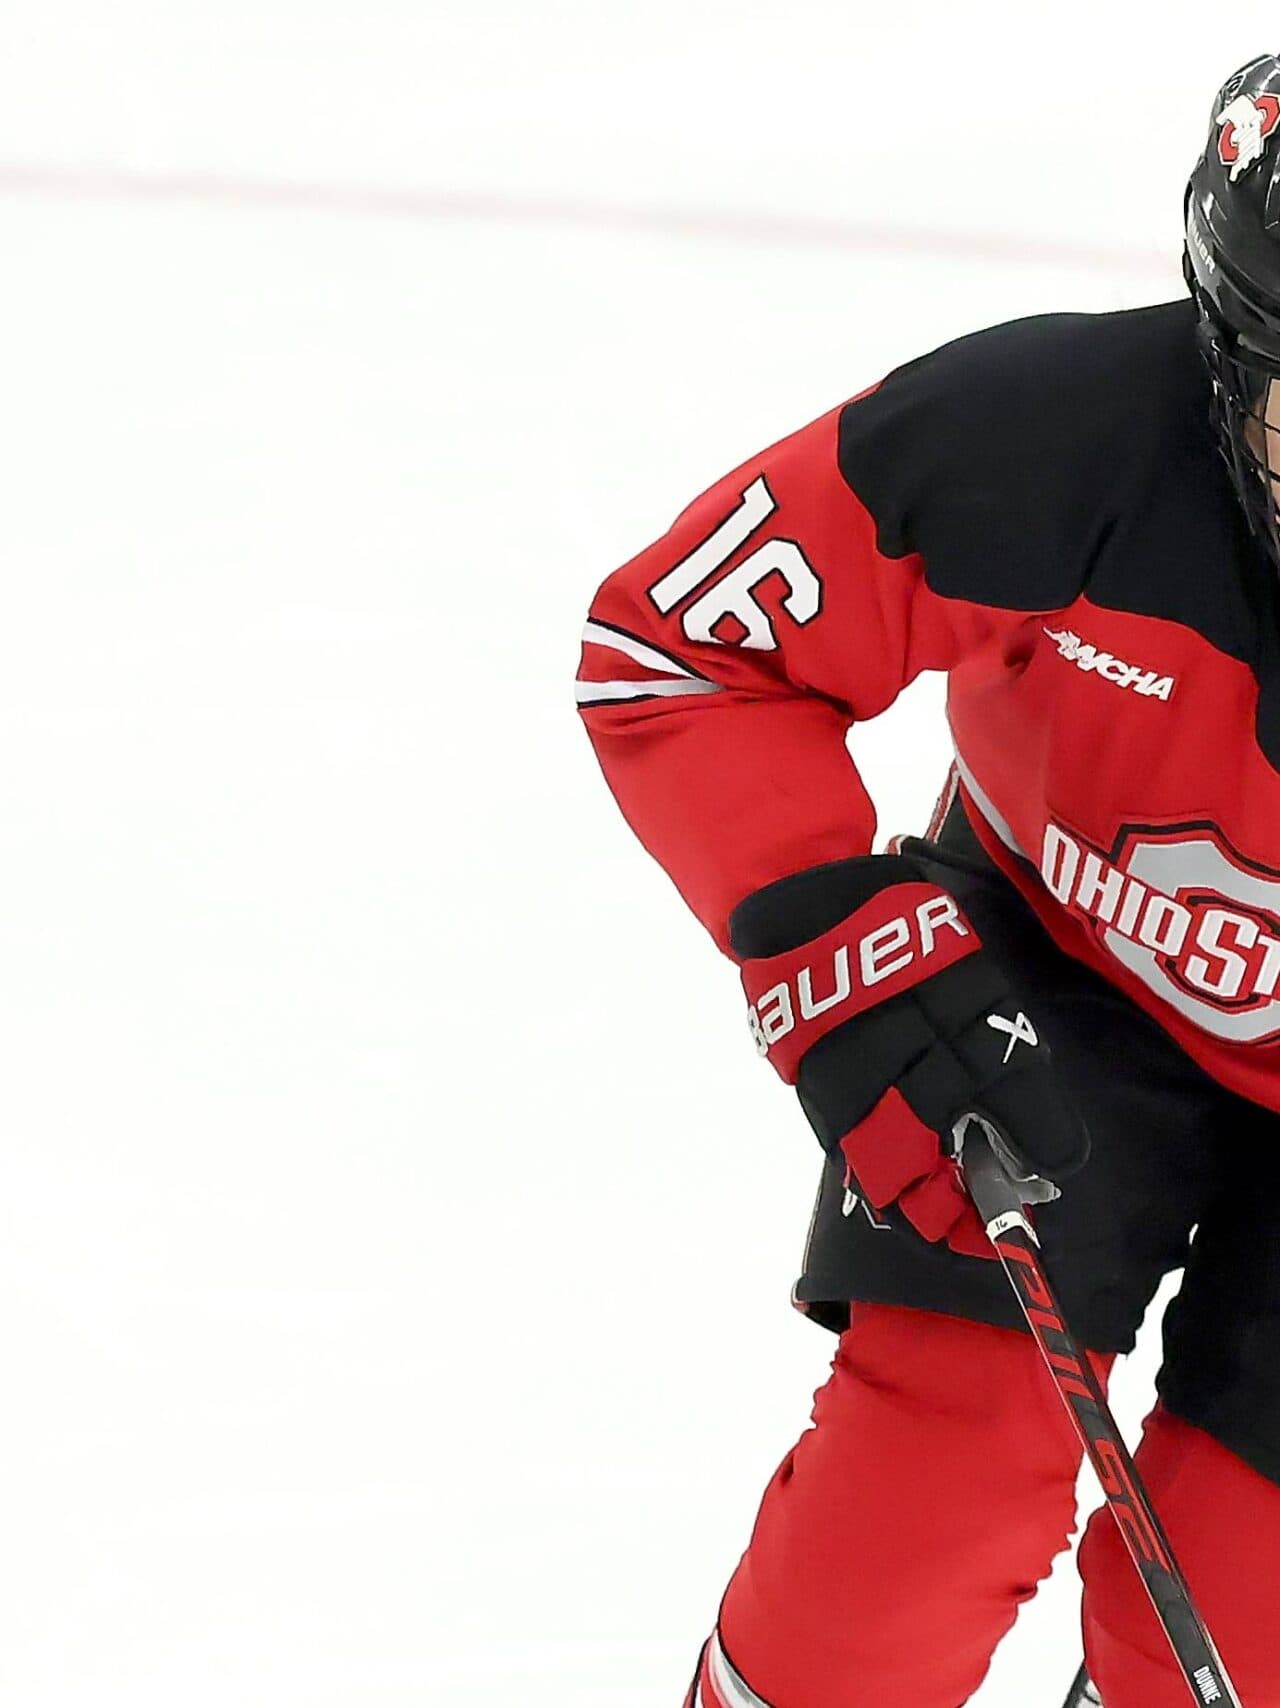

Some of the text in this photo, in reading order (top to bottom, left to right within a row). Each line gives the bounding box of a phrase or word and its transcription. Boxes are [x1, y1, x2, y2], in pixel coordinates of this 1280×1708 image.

[647, 472, 826, 653] 16
[1040, 823, 1192, 957] OHIO
[996, 1241, 1172, 1575] PULSE
[1192, 1665, 1222, 1705] DUNNE
